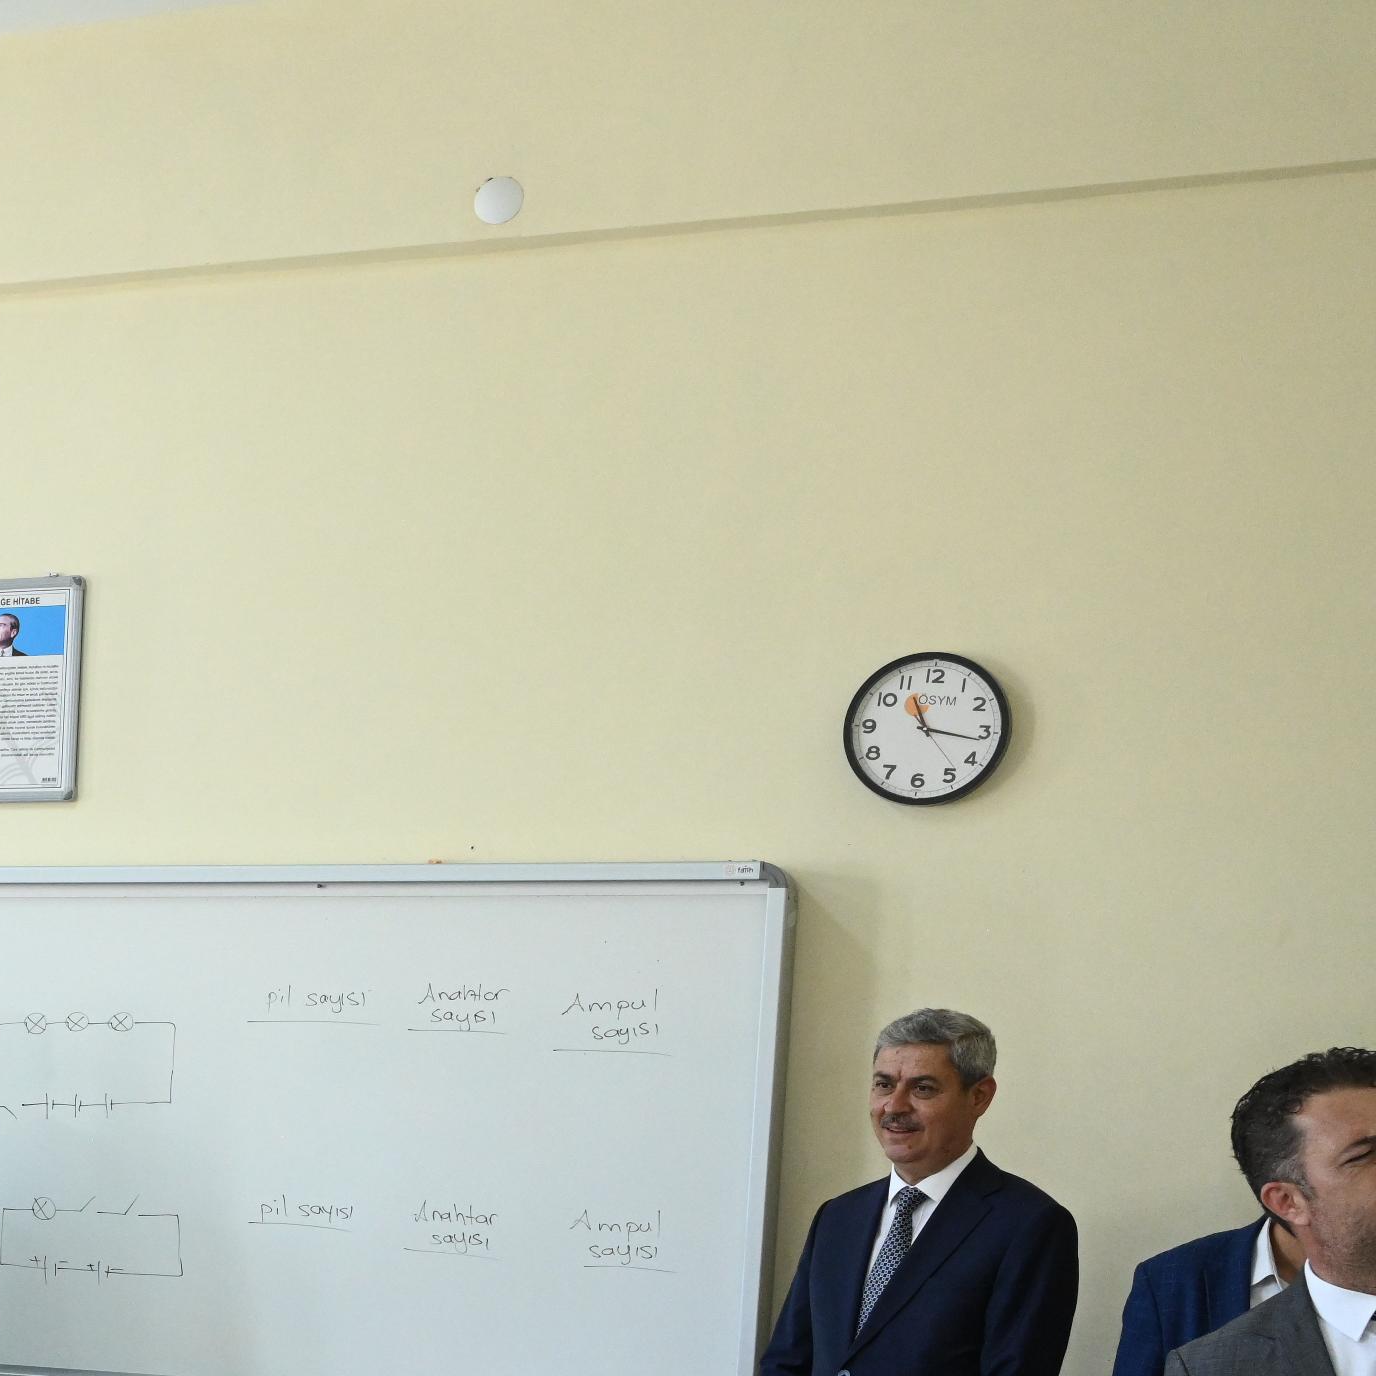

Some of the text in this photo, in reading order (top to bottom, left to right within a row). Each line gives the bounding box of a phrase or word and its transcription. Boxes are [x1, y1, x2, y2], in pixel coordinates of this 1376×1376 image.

[13, 596, 41, 606] HİTABE
[899, 675, 913, 691] 11
[925, 668, 946, 684] 12
[961, 678, 967, 693] 1
[877, 692, 898, 708] 10
[918, 692, 957, 707] ÖSYM
[972, 696, 987, 712] 2
[861, 718, 877, 734] 9
[978, 725, 992, 740] 3
[865, 745, 881, 761] 8
[964, 751, 978, 767] 4
[882, 764, 897, 780] 7
[942, 767, 957, 784] 5
[910, 773, 925, 788] 6
[561, 987, 658, 1021] Ampul
[413, 1199, 498, 1226] Anahtar
[569, 1209, 661, 1242] Ampul
